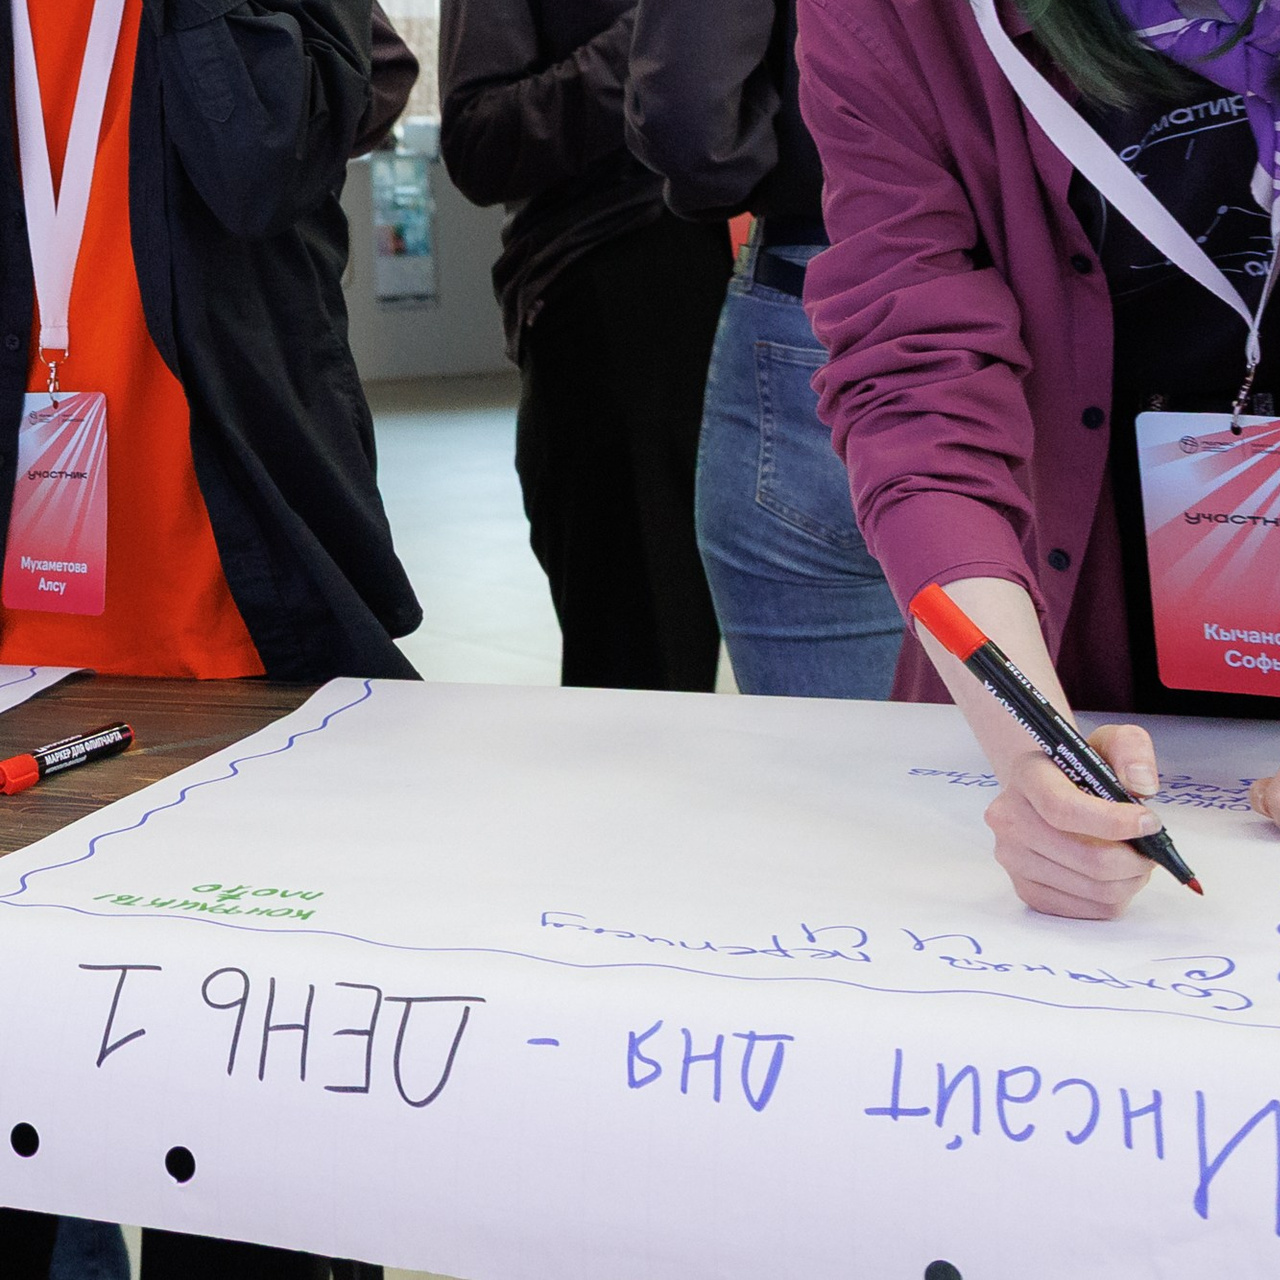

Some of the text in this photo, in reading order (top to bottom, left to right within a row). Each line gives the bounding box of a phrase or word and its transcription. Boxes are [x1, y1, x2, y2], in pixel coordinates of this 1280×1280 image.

[20, 556, 88, 574] Мухаметова
[38, 577, 66, 595] Алсу
[44, 747, 72, 766] МАРКЕР
[70, 743, 87, 760] ДЛЯ
[84, 730, 123, 753] ФЛИПЧАРТА
[78, 963, 163, 1069] 1
[201, 966, 487, 1109] ДЕНЬ
[627, 1020, 795, 1114] дня
